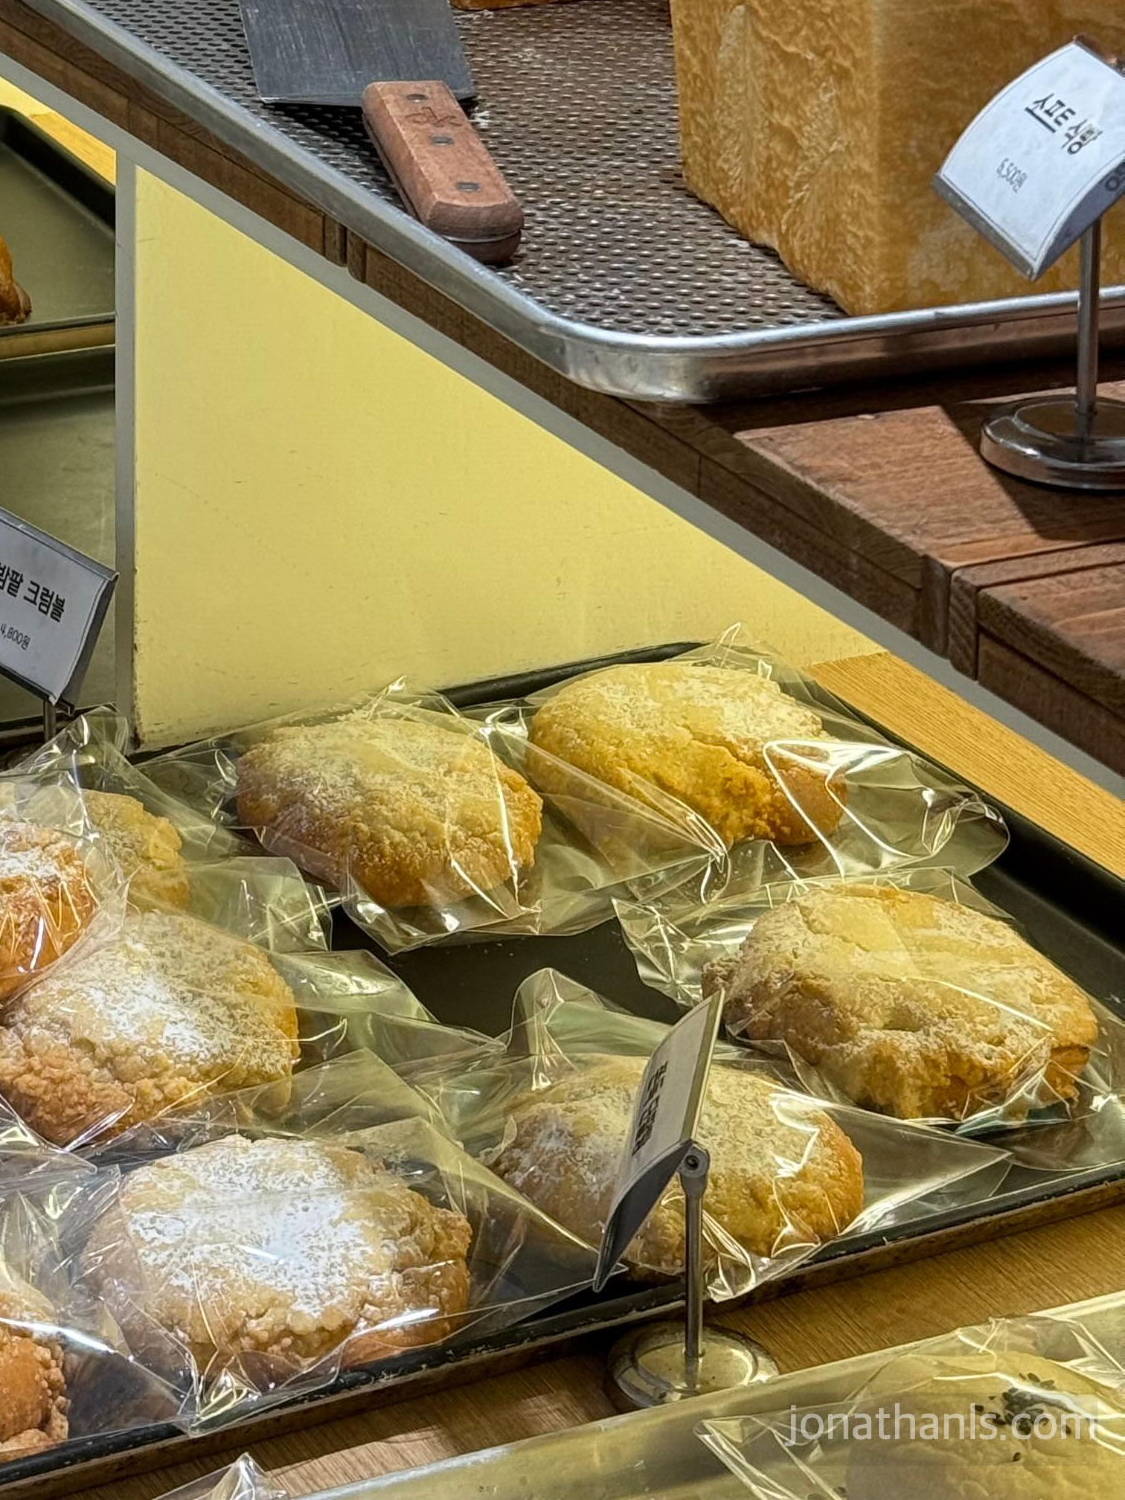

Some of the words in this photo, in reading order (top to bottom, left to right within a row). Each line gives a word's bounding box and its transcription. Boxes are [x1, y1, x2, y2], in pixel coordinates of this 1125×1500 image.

[1061, 118, 1103, 155] 식빵
[22, 580, 66, 623] 크럼블
[0, 622, 32, 651] 4,800원
